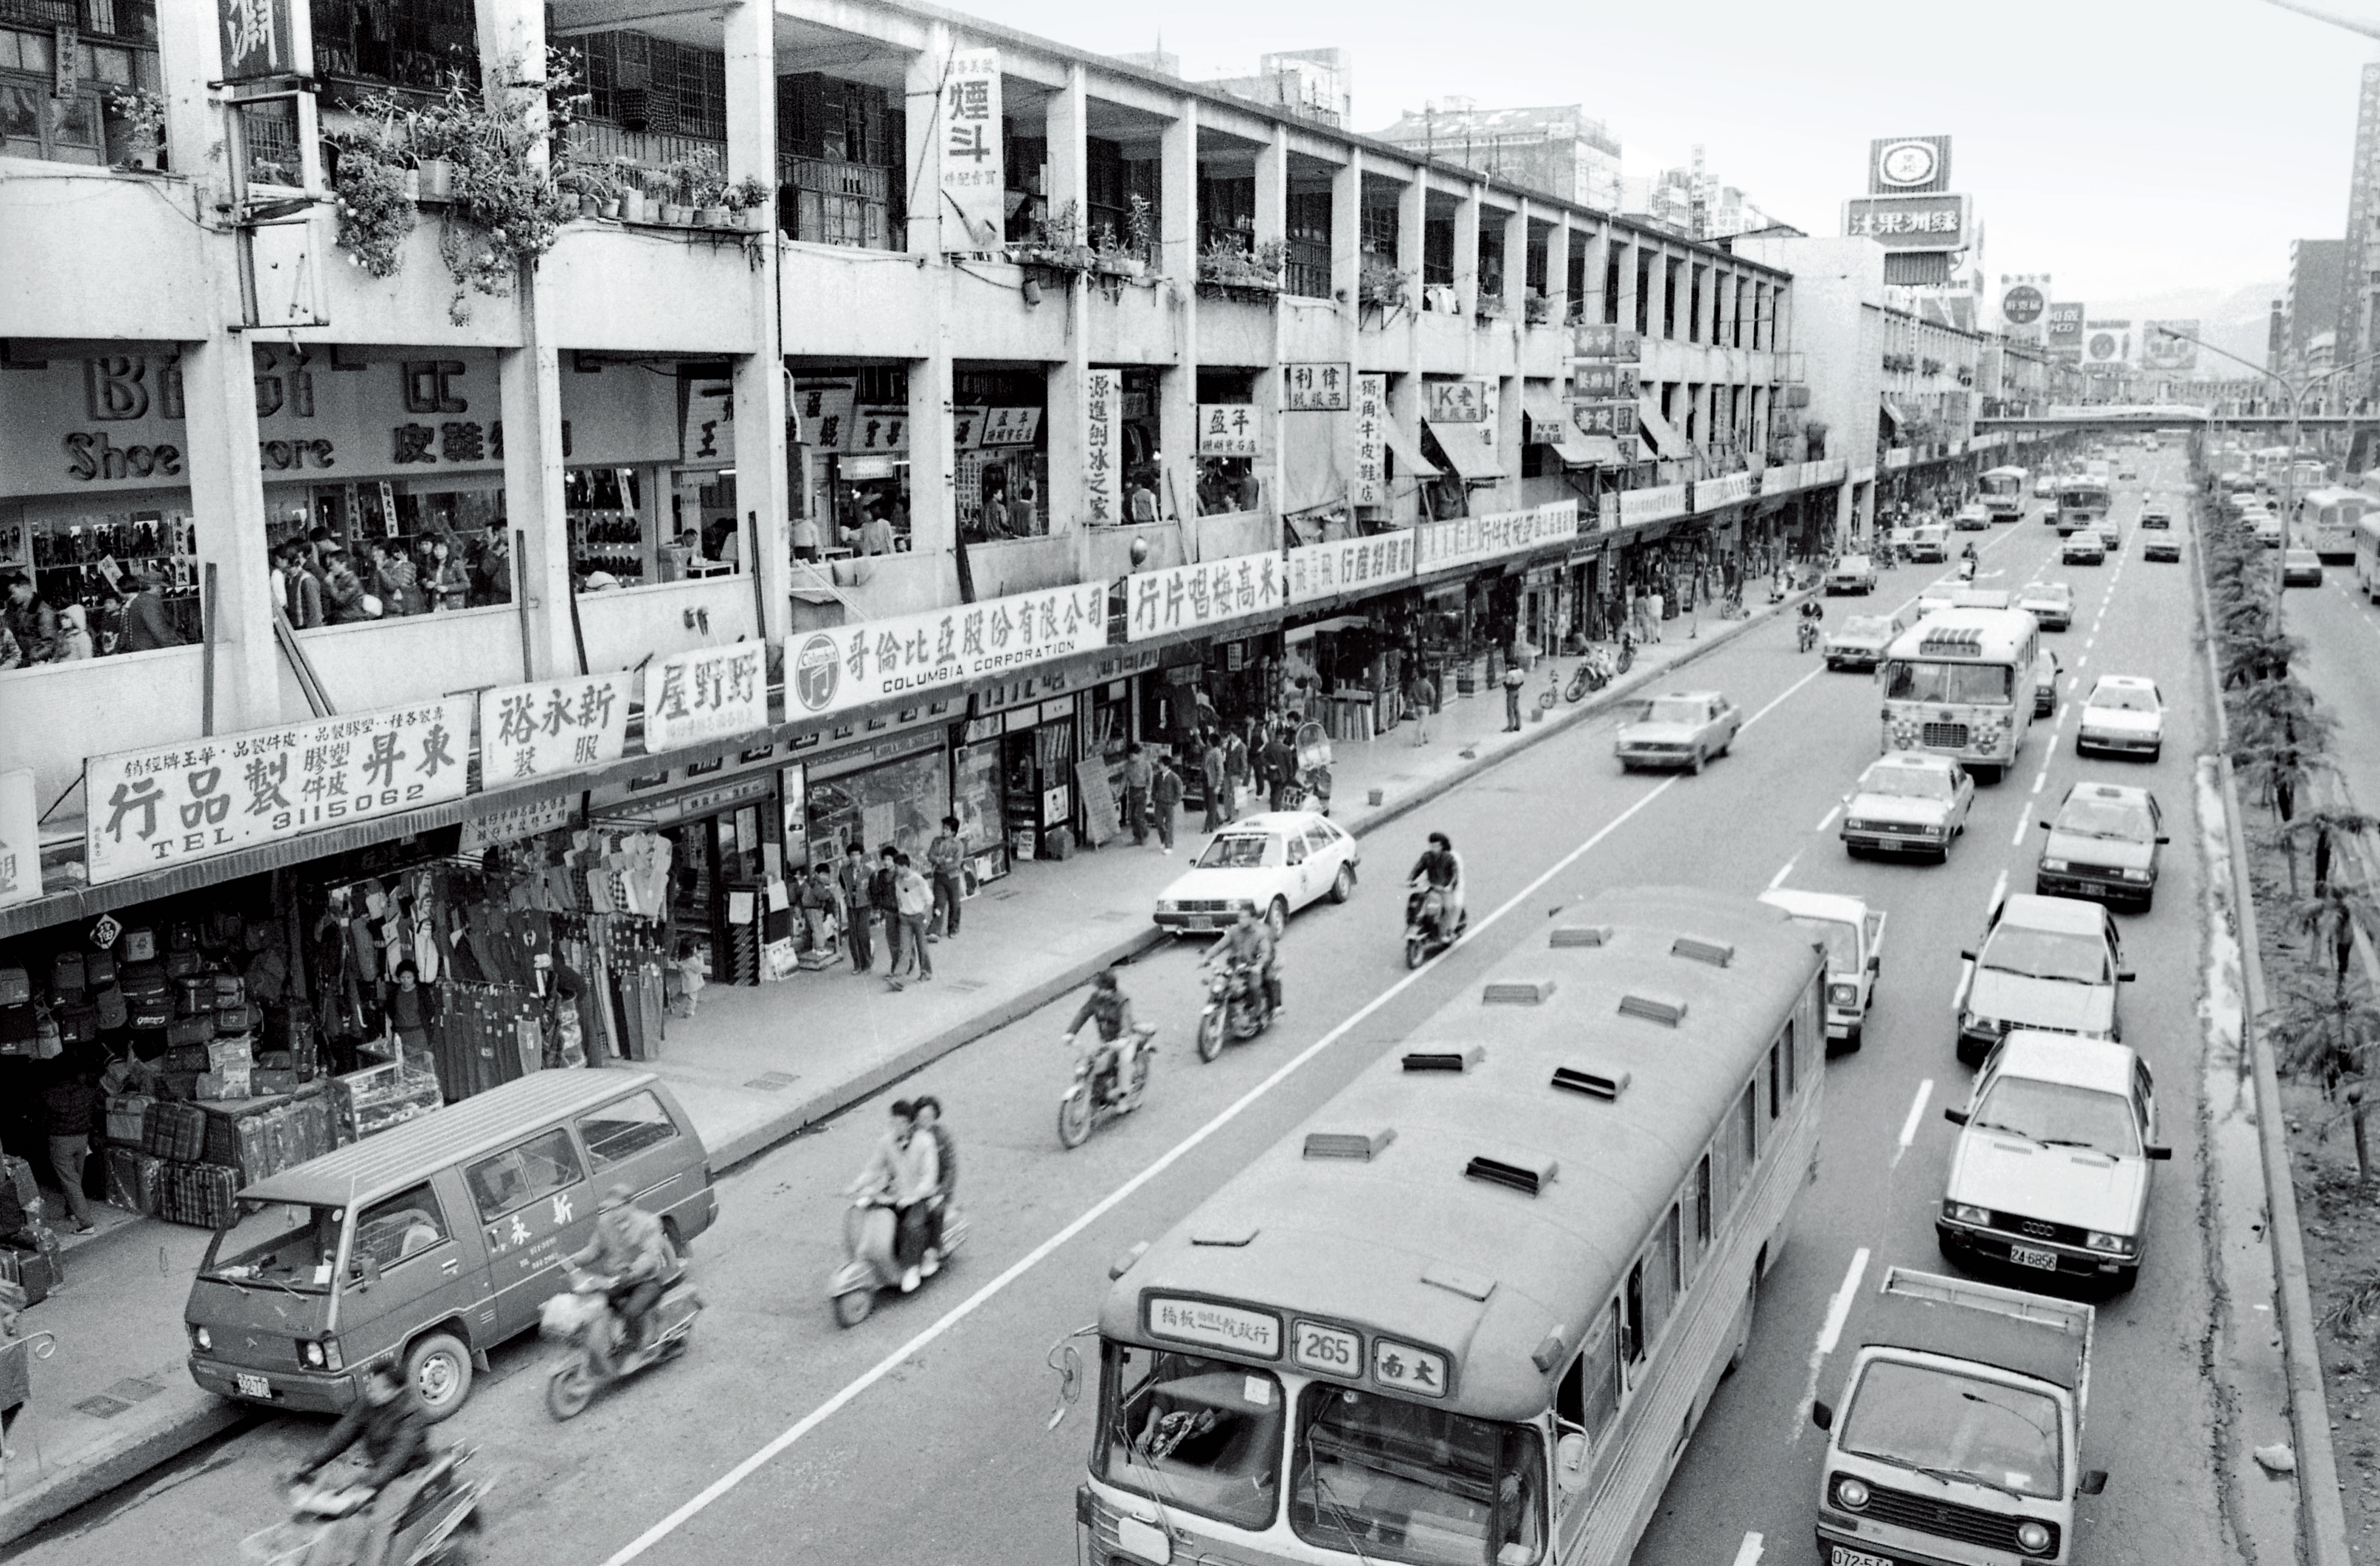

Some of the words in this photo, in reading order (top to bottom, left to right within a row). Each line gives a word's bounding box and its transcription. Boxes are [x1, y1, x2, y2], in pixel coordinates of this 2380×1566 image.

[948, 80, 990, 164] 煙斗
[1850, 211, 1958, 235] 綠洲果汁
[66, 432, 181, 481] Shoe
[258, 439, 335, 471] ore
[1135, 556, 1278, 631] 米高梅唱片行
[847, 587, 1103, 682] 哥倫比亞股份有限公司
[883, 665, 964, 693] COLUMBIA
[974, 640, 1075, 673] CORPORATION
[499, 683, 616, 747] 新永裕
[513, 734, 599, 778] 服裝
[273, 784, 424, 830] 3115062
[96, 922, 114, 943] 福
[1305, 1332, 1349, 1365] 265
[1382, 1354, 1436, 1386] 大南
